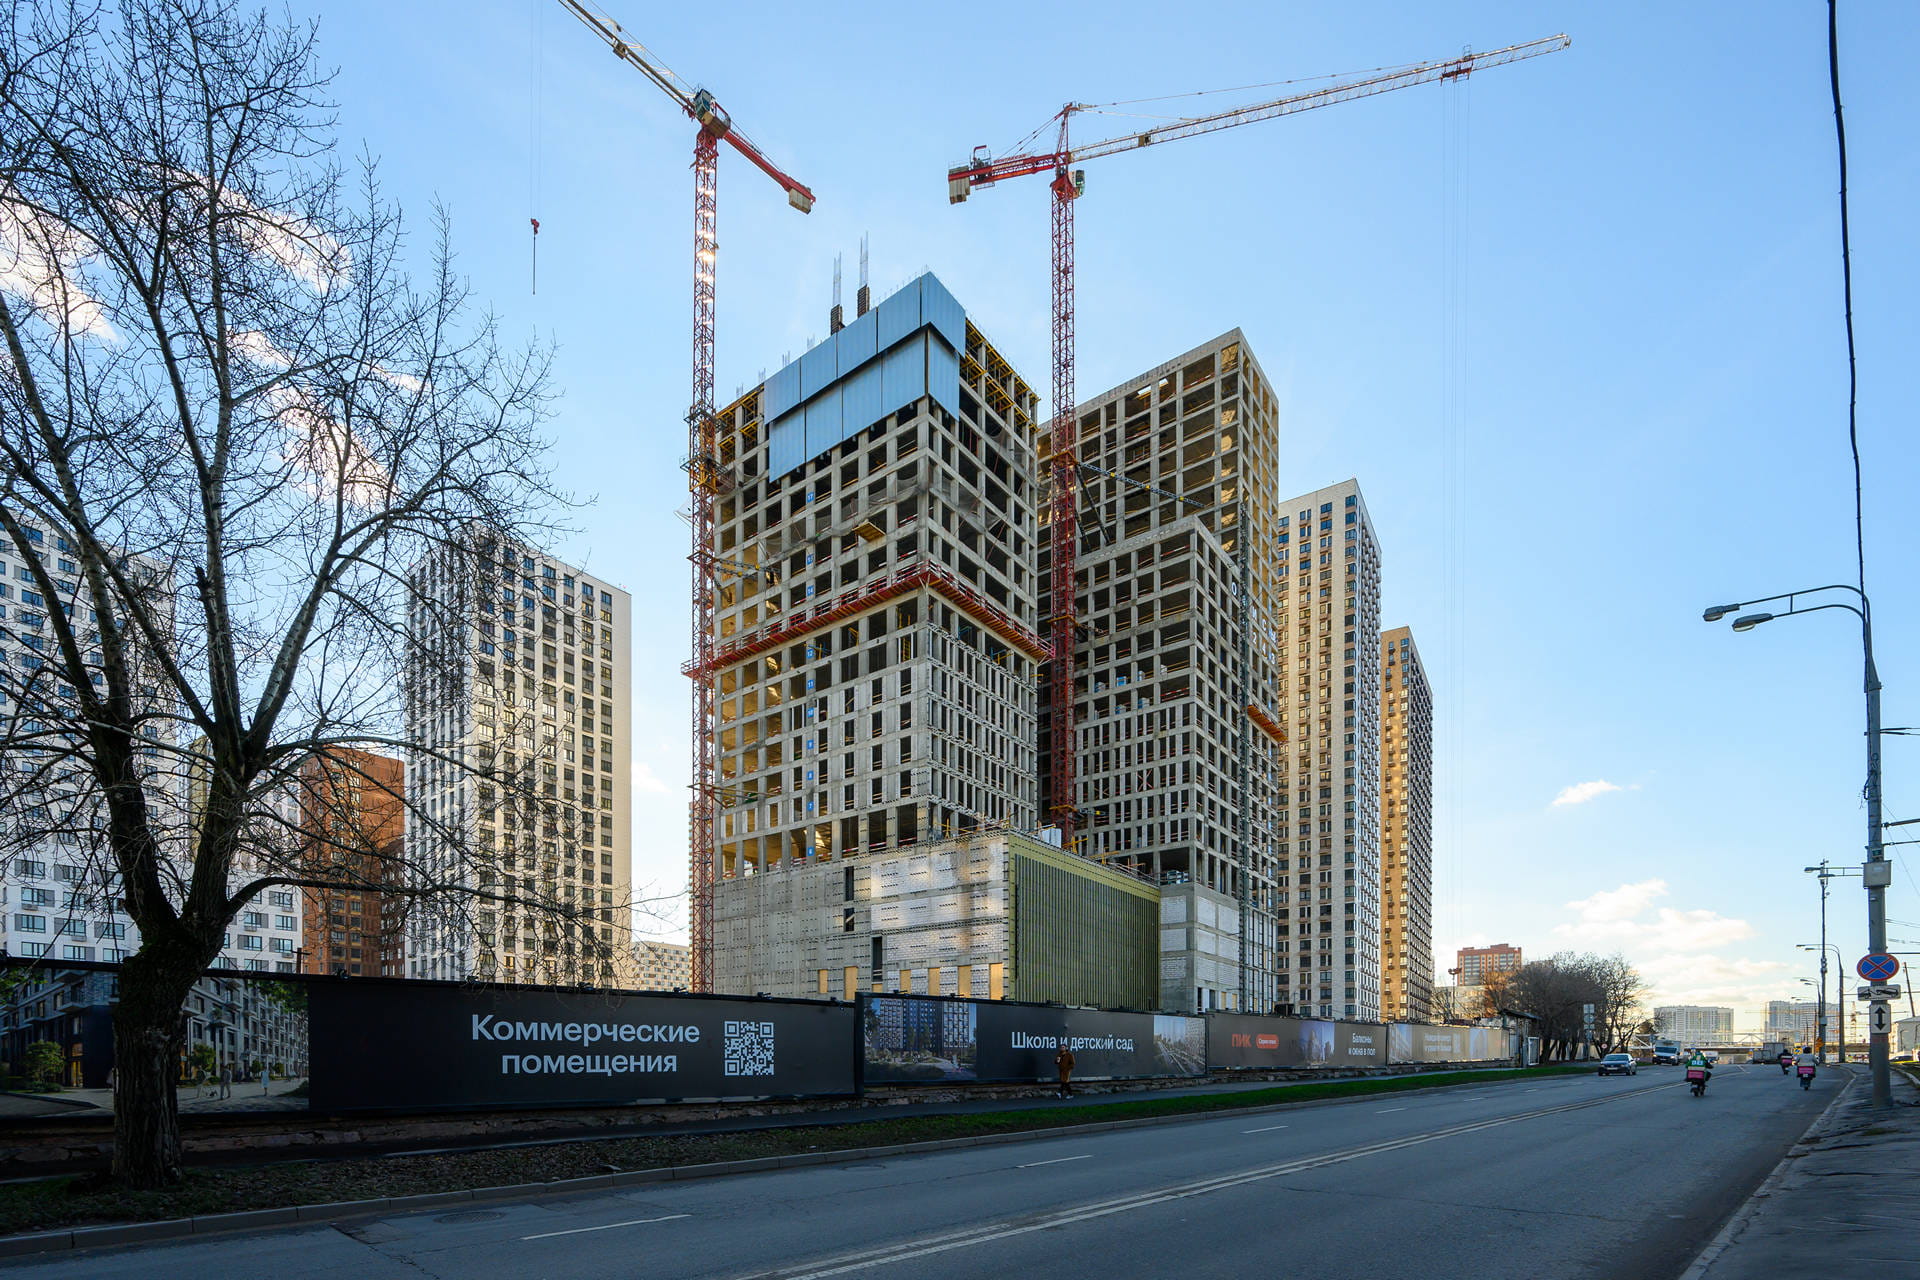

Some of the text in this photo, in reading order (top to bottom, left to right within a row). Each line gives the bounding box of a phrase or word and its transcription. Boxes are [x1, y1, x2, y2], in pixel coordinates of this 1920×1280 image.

[471, 1014, 700, 1047] Коммерческие
[1011, 1031, 1057, 1049] Школа
[1070, 1034, 1114, 1051] детский
[1115, 1036, 1134, 1051] сад
[1231, 1033, 1252, 1048] ПИК
[502, 1055, 677, 1077] помещения
